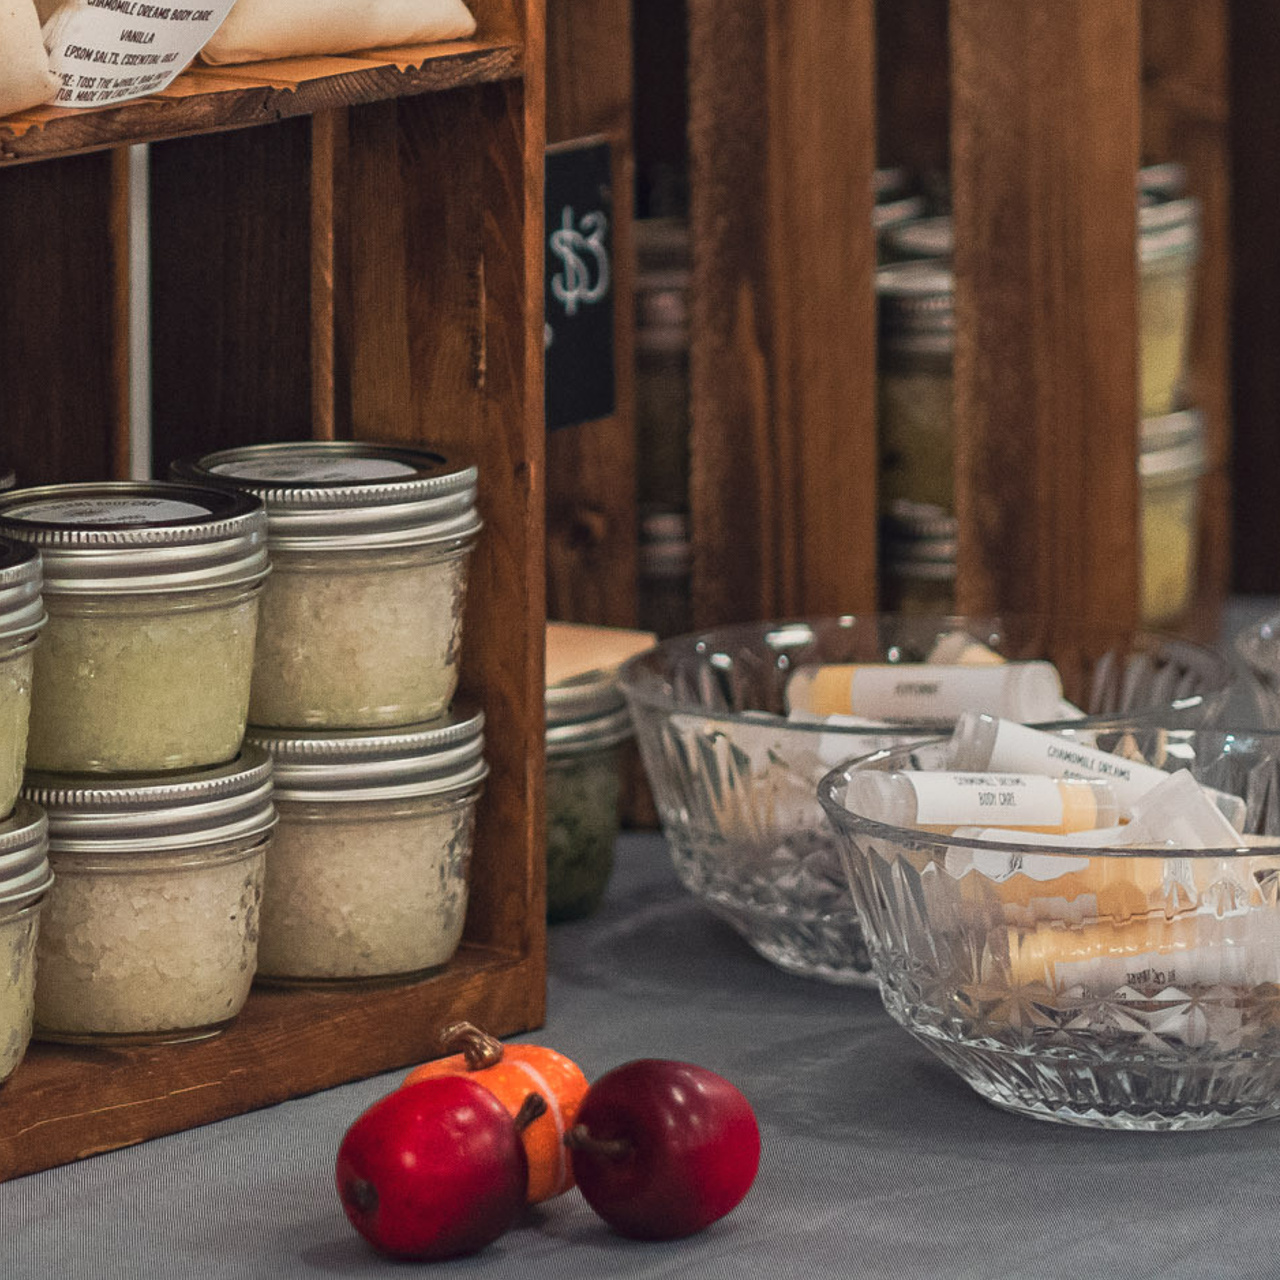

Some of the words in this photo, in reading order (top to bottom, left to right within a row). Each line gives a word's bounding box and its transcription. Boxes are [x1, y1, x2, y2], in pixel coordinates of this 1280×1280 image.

[136, 4, 171, 20] DREAMS
[170, 8, 192, 21] BODY
[191, 9, 214, 21] CARE
[119, 29, 156, 44] VANILLA
[64, 45, 93, 61] EPSOM
[120, 52, 161, 66] ESSENTIAL
[76, 76, 96, 89] TOSS
[95, 77, 113, 89] THE
[74, 90, 99, 101] MADE
[977, 791, 997, 807] BODY
[998, 791, 1017, 807] CARE
